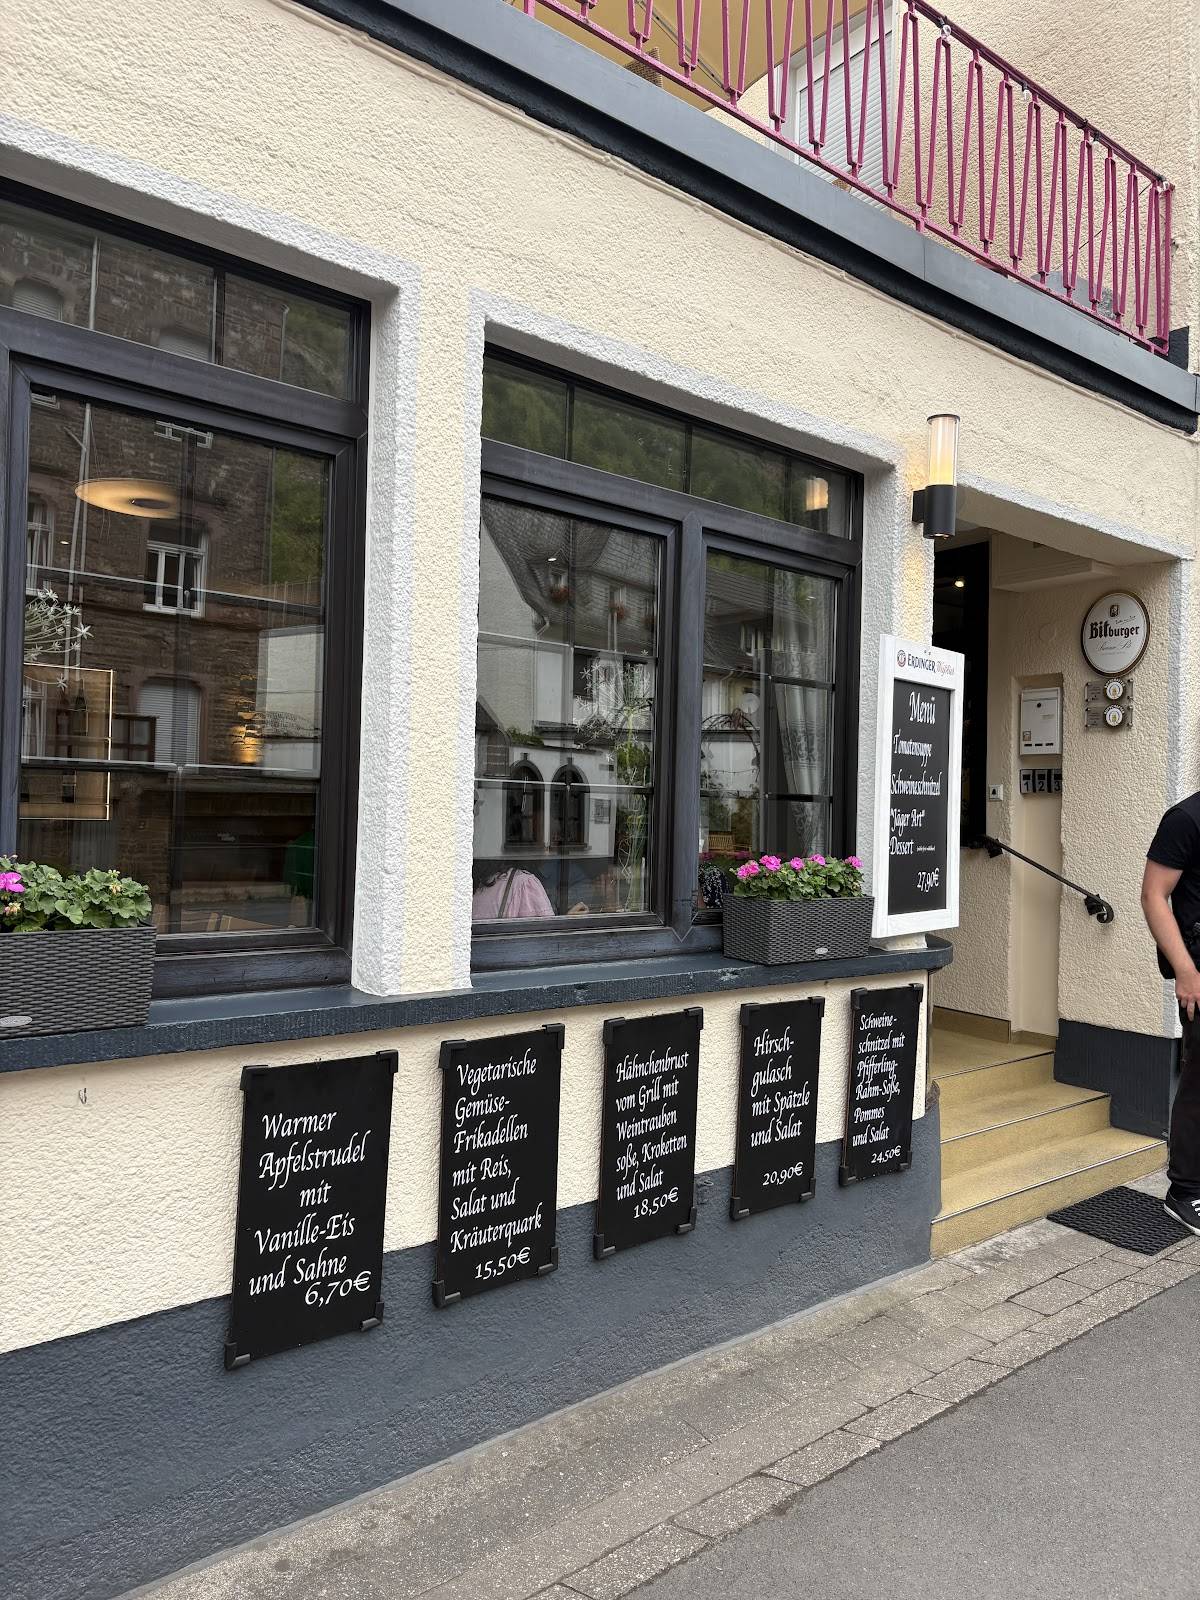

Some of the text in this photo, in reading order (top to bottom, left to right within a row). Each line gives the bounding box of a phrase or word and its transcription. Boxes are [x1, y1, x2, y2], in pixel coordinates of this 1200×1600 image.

[1089, 620, 1139, 639] Bitburger
[908, 653, 936, 673] ERDINGER
[909, 691, 935, 724] Menü
[891, 769, 942, 795] Schweineschnitzel
[1024, 781, 1060, 791] 1 2 3
[890, 836, 914, 854] Dessert
[917, 868, 939, 892] 27,90€
[860, 1013, 898, 1031] Schweine-
[753, 1026, 794, 1057] Hirsch-
[858, 1030, 906, 1054] schnitzel mit
[456, 1048, 537, 1097] Vegetarische
[616, 1047, 690, 1083] Hähnchenbrust
[750, 1054, 793, 1097] gulasch
[857, 1053, 898, 1084] Pfifferling-
[616, 1076, 679, 1112] vom Grill mit
[752, 1080, 810, 1122] mit Spätzle
[855, 1075, 900, 1102] Rahm-Soße,
[262, 1111, 338, 1140] Warmer
[455, 1094, 511, 1128] Gemüse-
[616, 1103, 677, 1142] Weintrauben
[854, 1106, 885, 1123] Pommes
[454, 1114, 529, 1154] Frikadellen
[751, 1113, 802, 1147] und Salat
[853, 1121, 889, 1147] und Salat
[259, 1130, 371, 1190] Apfelstrudel
[616, 1132, 687, 1180] soße, Kroketten
[871, 1145, 902, 1164] 24,50€
[452, 1156, 512, 1187] mit Reis,
[616, 1163, 664, 1201] und Salat
[762, 1162, 804, 1186] 20,90€
[299, 1179, 332, 1208] mit
[451, 1177, 520, 1221] Salat und
[633, 1187, 679, 1219] 18,50€
[255, 1211, 356, 1254] Vanille-Eis
[450, 1202, 544, 1253] Kräuterquark
[249, 1254, 348, 1297] und Sahne
[474, 1247, 531, 1281] 15,50€
[304, 1270, 372, 1306] 6,70€
